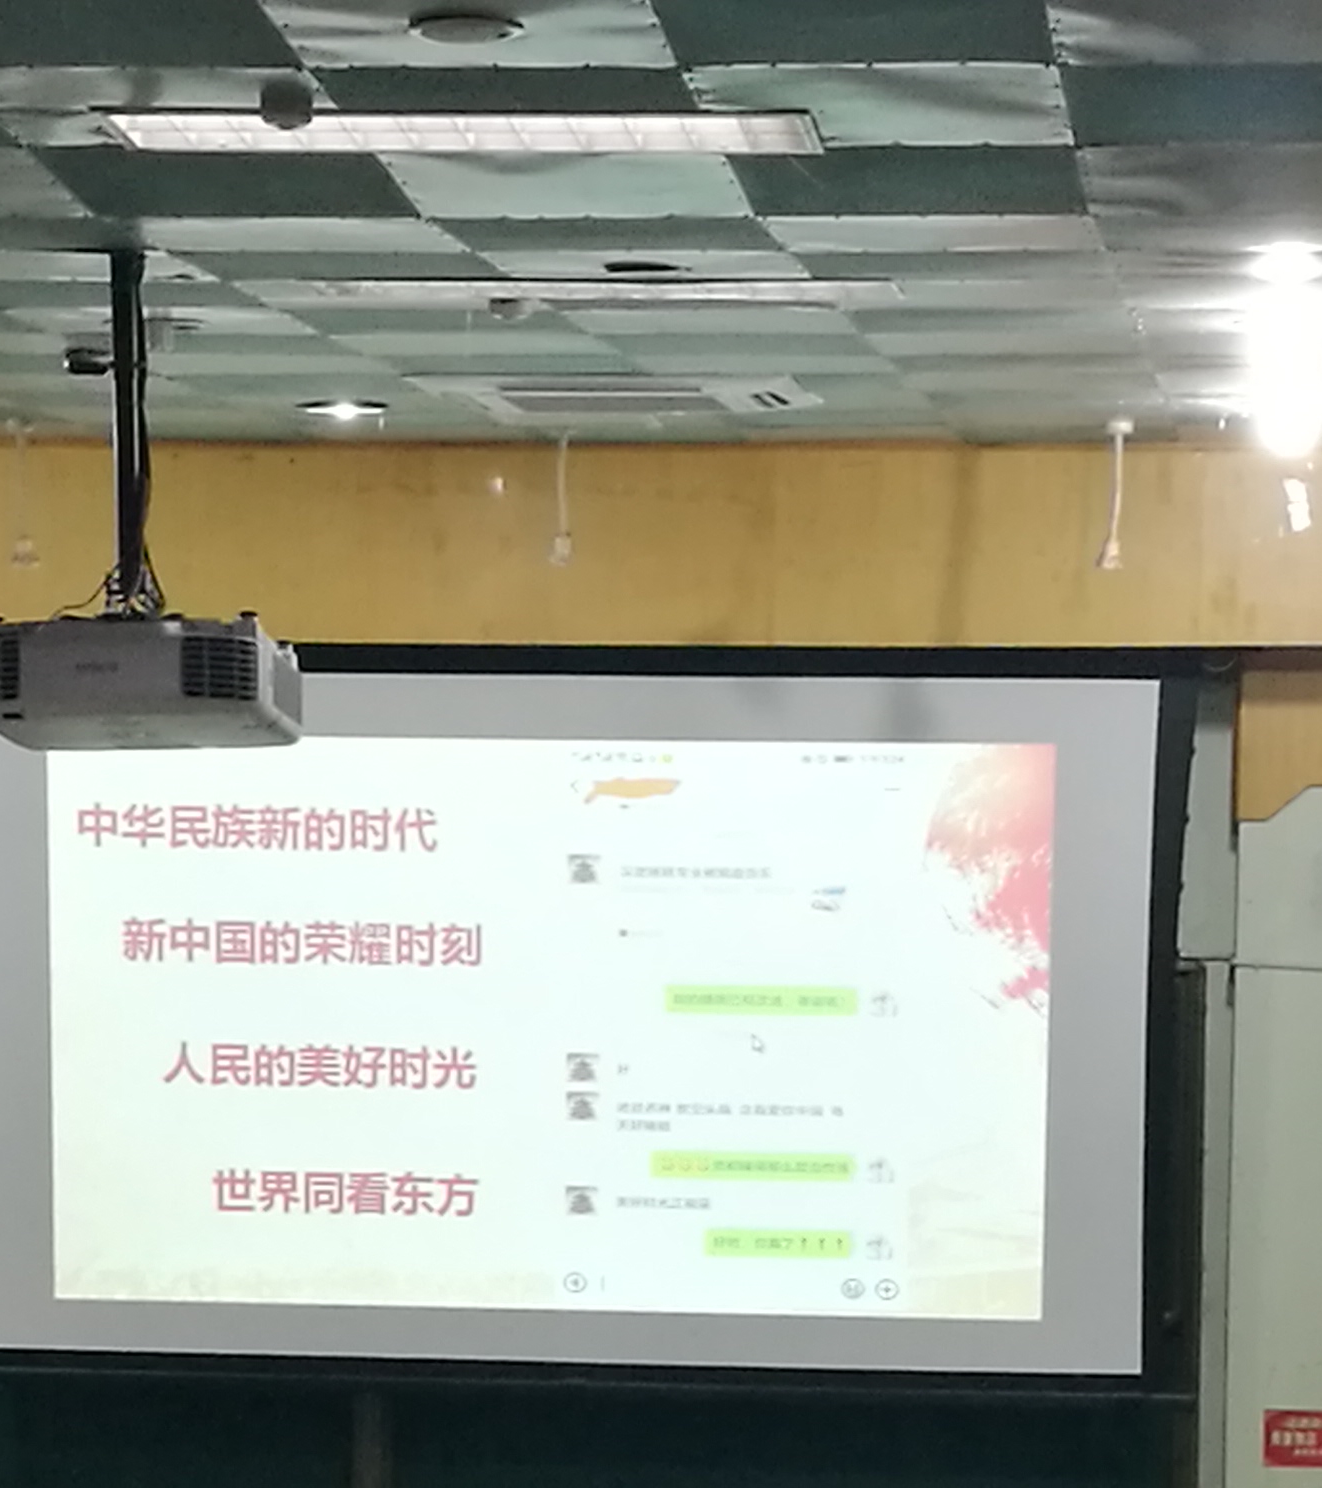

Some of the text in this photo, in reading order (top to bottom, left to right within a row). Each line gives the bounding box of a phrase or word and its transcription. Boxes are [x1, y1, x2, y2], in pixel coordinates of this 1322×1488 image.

[77, 802, 438, 853] 中华民族新的时代
[122, 917, 483, 967] 新中国的荣耀时刻
[163, 1041, 477, 1090] 人民的美好时光
[212, 1168, 480, 1217] 世界同看东方
